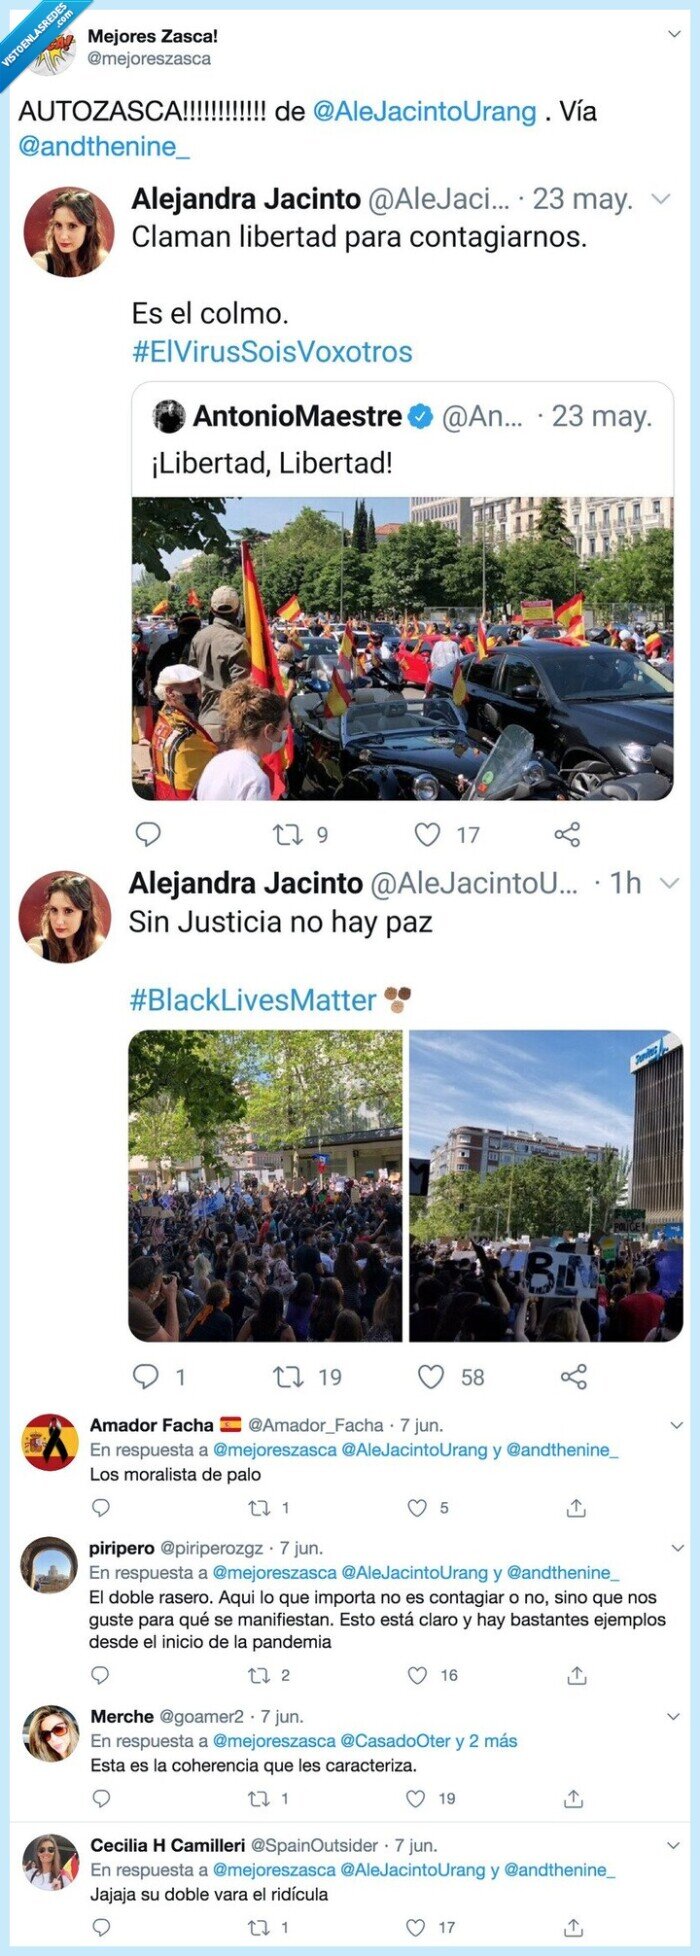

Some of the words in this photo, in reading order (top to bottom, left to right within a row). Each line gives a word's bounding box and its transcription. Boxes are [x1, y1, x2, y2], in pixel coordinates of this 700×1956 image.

[87, 28, 157, 47] Mejores
[160, 28, 218, 44] Zasca!
[87, 50, 212, 69] @mejoreszasca
[17, 99, 266, 122] AUTOZASCA!!!!!!!!!!!!
[274, 100, 306, 122] de
[313, 99, 537, 128] @AleJacintoUrang
[558, 98, 598, 122] Vía
[18, 134, 191, 160] @andthenine_
[130, 185, 257, 216] Alejandra
[263, 186, 362, 210] Jacinto
[533, 186, 565, 210] 23
[573, 192, 633, 216] may.
[132, 223, 231, 248] Claman
[240, 223, 337, 248] libertad
[345, 229, 402, 254] para
[409, 224, 587, 254] contagiarnos.
[132, 301, 163, 325] Es
[170, 300, 192, 325] el
[200, 300, 288, 325] colmo.
[132, 338, 413, 363] #ElVirusSoisVoxotros
[192, 403, 403, 428] AntonioMaestre
[552, 403, 584, 427] 23
[592, 409, 652, 433] may.
[152, 449, 271, 479] ¡Libertad,
[280, 449, 392, 475] Libertad!
[317, 826, 329, 844] 9
[457, 826, 480, 844] 17
[128, 869, 256, 901] Alejandra
[263, 870, 364, 895] Jacinto
[610, 869, 641, 895] 1h
[128, 909, 169, 934] Sin
[177, 909, 282, 934] Justicia
[290, 914, 324, 934] no
[332, 908, 378, 940] hay
[386, 914, 433, 939] paz
[129, 986, 378, 1012] #BlackLivesMatter
[176, 1368, 184, 1386] 1
[319, 1368, 342, 1386] 19
[461, 1368, 485, 1387] 58
[89, 1417, 159, 1433] Amador
[162, 1417, 214, 1433] Facha
[248, 1417, 384, 1435] @Amador_Facha
[400, 1417, 410, 1433] 7
[414, 1417, 443, 1436] jun.
[90, 1442, 111, 1457] En
[116, 1443, 195, 1461] respuesta
[198, 1445, 209, 1457] a
[213, 1441, 338, 1461] @mejoreszasca
[341, 1441, 488, 1461] @AleJacintoUrang
[492, 1445, 503, 1461] y
[506, 1441, 619, 1459] @andthenine_
[90, 1466, 120, 1482] Los
[124, 1466, 198, 1482] moralista
[201, 1466, 223, 1482] de
[226, 1466, 262, 1485] palo
[282, 1501, 289, 1514] 1
[440, 1501, 449, 1515] 5
[88, 1540, 156, 1559] piripero
[160, 1540, 264, 1559] @piriperozgz
[280, 1540, 290, 1555] 7
[294, 1540, 323, 1559] jun.
[89, 1565, 110, 1580] En
[115, 1565, 194, 1583] respuesta
[198, 1568, 209, 1580] a
[212, 1564, 338, 1583] @mejoreszasca
[341, 1564, 489, 1584] @AleJacintoUrang
[493, 1568, 503, 1584] y
[507, 1564, 620, 1582] @andthenine_
[89, 1589, 104, 1605] El
[108, 1589, 155, 1605] doble
[159, 1592, 214, 1605] rasero.
[217, 1589, 255, 1608] Aqui
[260, 1589, 275, 1605] lo
[278, 1592, 310, 1608] que
[314, 1589, 377, 1608] importa
[380, 1592, 401, 1605] no
[405, 1592, 425, 1605] es
[429, 1589, 505, 1608] contagiar
[508, 1592, 520, 1605] o
[524, 1592, 549, 1607] no,
[554, 1589, 588, 1605] sino
[592, 1592, 623, 1608] que
[627, 1592, 658, 1605] nos
[88, 1612, 134, 1631] guste
[138, 1615, 175, 1630] para
[178, 1610, 210, 1630] qué
[214, 1615, 234, 1627] se
[237, 1611, 334, 1627] manifiestan.
[339, 1611, 376, 1627] Esto
[380, 1610, 415, 1627] está
[418, 1612, 459, 1627] claro
[462, 1615, 473, 1631] y
[476, 1612, 506, 1631] hay
[510, 1612, 590, 1627] bastantes
[593, 1612, 667, 1630] ejemplos
[88, 1634, 139, 1649] desde
[143, 1634, 157, 1649] el
[162, 1634, 204, 1649] inicio
[208, 1634, 230, 1649] de
[234, 1634, 248, 1649] la
[252, 1634, 333, 1653] pandemia
[281, 1668, 290, 1682] 2
[441, 1668, 458, 1682] 16
[90, 1709, 155, 1724] Merche
[159, 1708, 244, 1727] @goamer2
[261, 1709, 271, 1724] 7
[274, 1709, 304, 1727] jun.
[91, 1733, 111, 1748] En
[116, 1734, 195, 1752] respuesta
[198, 1736, 209, 1748] a
[213, 1732, 337, 1752] @mejoreszasca
[340, 1732, 452, 1748] @CasadoOter
[455, 1737, 465, 1752] y
[468, 1733, 479, 1748] 2
[484, 1732, 518, 1748] más
[90, 1757, 126, 1773] Esta
[129, 1760, 149, 1773] es
[153, 1757, 168, 1773] la
[171, 1757, 260, 1773] coherencia
[263, 1761, 294, 1776] que
[298, 1757, 322, 1773] les
[325, 1757, 417, 1773] caracteriza.
[281, 1792, 288, 1805] 1
[439, 1792, 456, 1805] 19
[90, 1837, 148, 1853] Cecilia
[153, 1837, 166, 1853] H
[170, 1837, 246, 1853] Camilleri
[251, 1837, 379, 1856] @SpainOutsider
[395, 1838, 405, 1852] 7
[408, 1838, 438, 1856] jun.
[91, 1862, 111, 1877] En
[116, 1863, 194, 1880] respuesta
[198, 1865, 209, 1877] a
[213, 1861, 337, 1881] @mejoreszasca
[340, 1861, 486, 1881] @AleJacintoUrang
[490, 1865, 500, 1881] y
[504, 1861, 616, 1879] @andthenine_
[89, 1886, 137, 1905] Jajaja
[140, 1890, 160, 1902] su
[164, 1886, 210, 1902] doble
[213, 1890, 249, 1902] vara
[252, 1886, 267, 1902] el
[271, 1885, 329, 1902] ridícula
[281, 1921, 288, 1934] 1
[439, 1921, 456, 1934] 17
